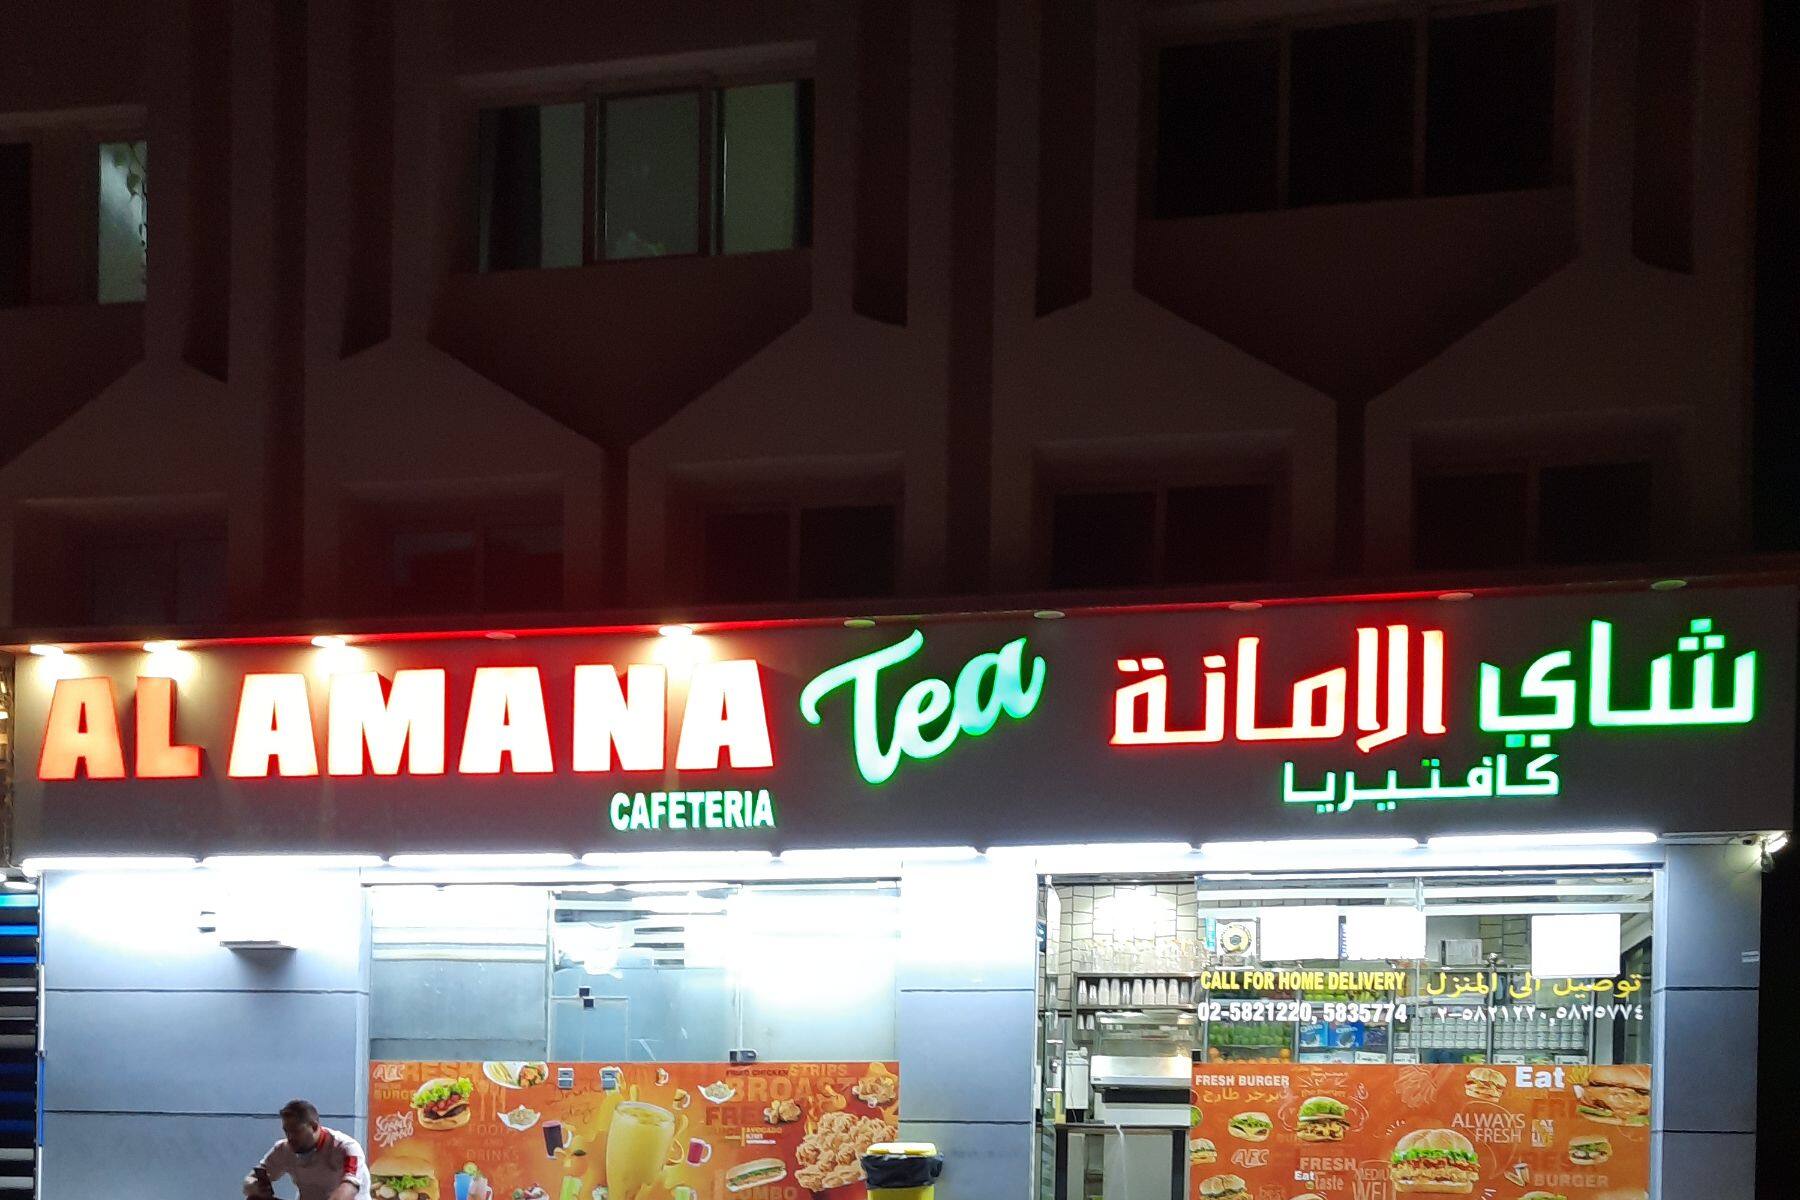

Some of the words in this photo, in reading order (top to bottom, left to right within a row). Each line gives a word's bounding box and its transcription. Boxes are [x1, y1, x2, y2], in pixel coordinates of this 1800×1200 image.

[1109, 624, 1447, 753] الامانة
[1479, 618, 1756, 749] شاي
[799, 628, 1047, 784] Tea
[38, 675, 204, 780] AL
[226, 658, 775, 778] AMANA
[1283, 753, 1560, 814] كافتيريا
[609, 788, 776, 832] CAFETERIA
[1200, 971, 1240, 991] CALL
[1243, 971, 1276, 990] FOR
[1278, 971, 1325, 990] HOME
[1328, 971, 1406, 991] DELIVERY
[1426, 971, 1498, 999] المنزل
[1197, 1002, 1318, 1025] 02-5821220,
[1323, 1002, 1408, 1023] 5835774
[789, 1064, 848, 1077] STRIPS
[1195, 1075, 1235, 1087] FRESH
[1238, 1075, 1290, 1087] BURGER
[1515, 1066, 1566, 1089] Eat
[1452, 1113, 1526, 1128] ALWAYS
[1475, 1129, 1522, 1144] FRESH
[1300, 1157, 1357, 1171] FRESH
[1294, 1171, 1316, 1181] Eat
[1534, 1174, 1609, 1187] BURGER
